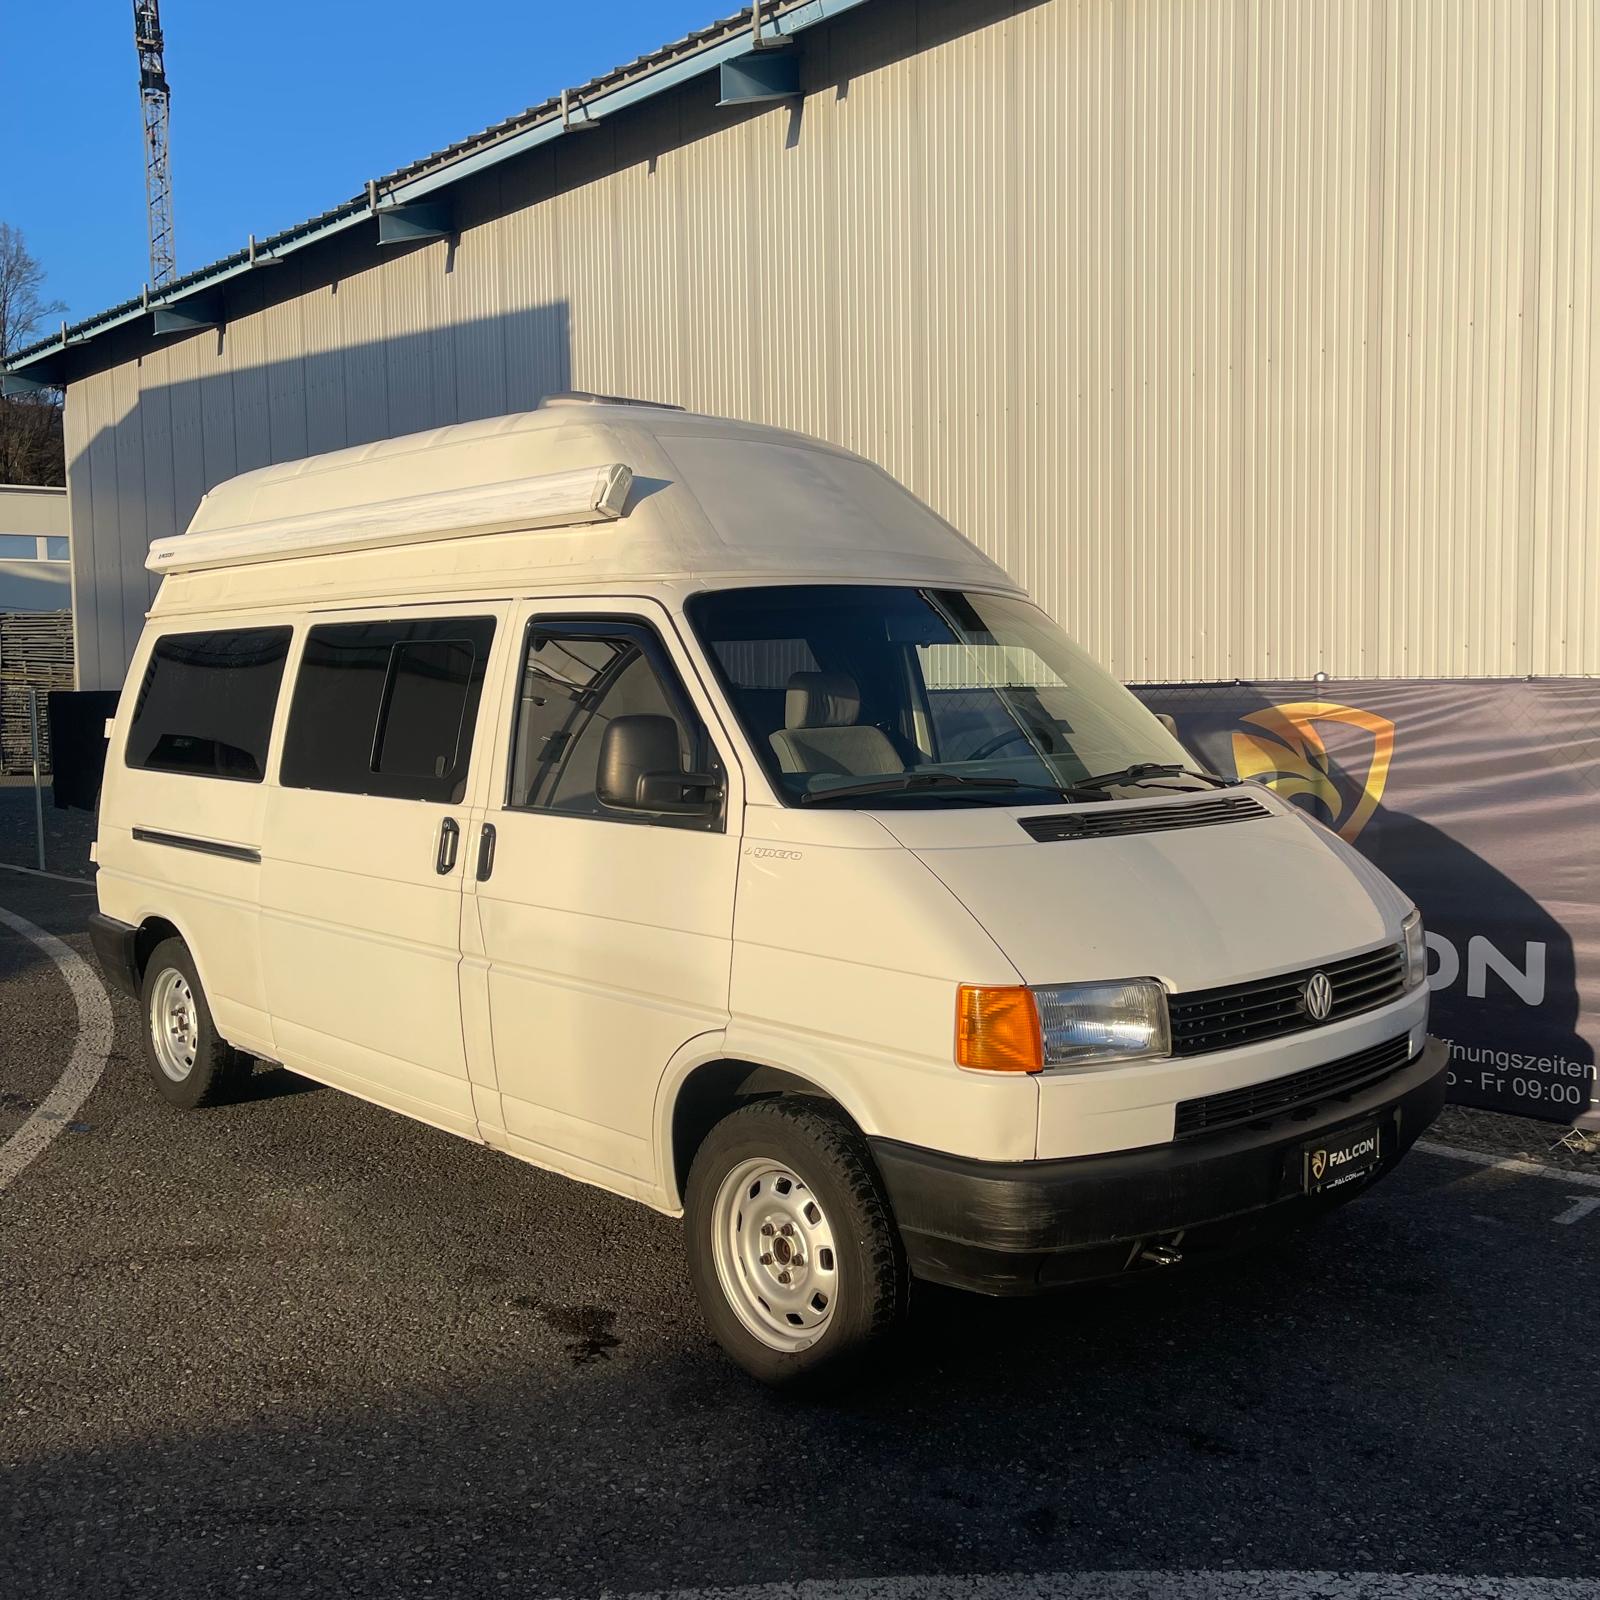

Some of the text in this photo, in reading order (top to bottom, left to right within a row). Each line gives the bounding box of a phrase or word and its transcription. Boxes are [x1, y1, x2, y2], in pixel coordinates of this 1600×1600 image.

[1426, 1032, 1597, 1080] fnungszeiten
[1481, 1071, 1506, 1093] Fr
[1512, 1077, 1581, 1105] 09:00
[1329, 1137, 1374, 1167] FALCON
